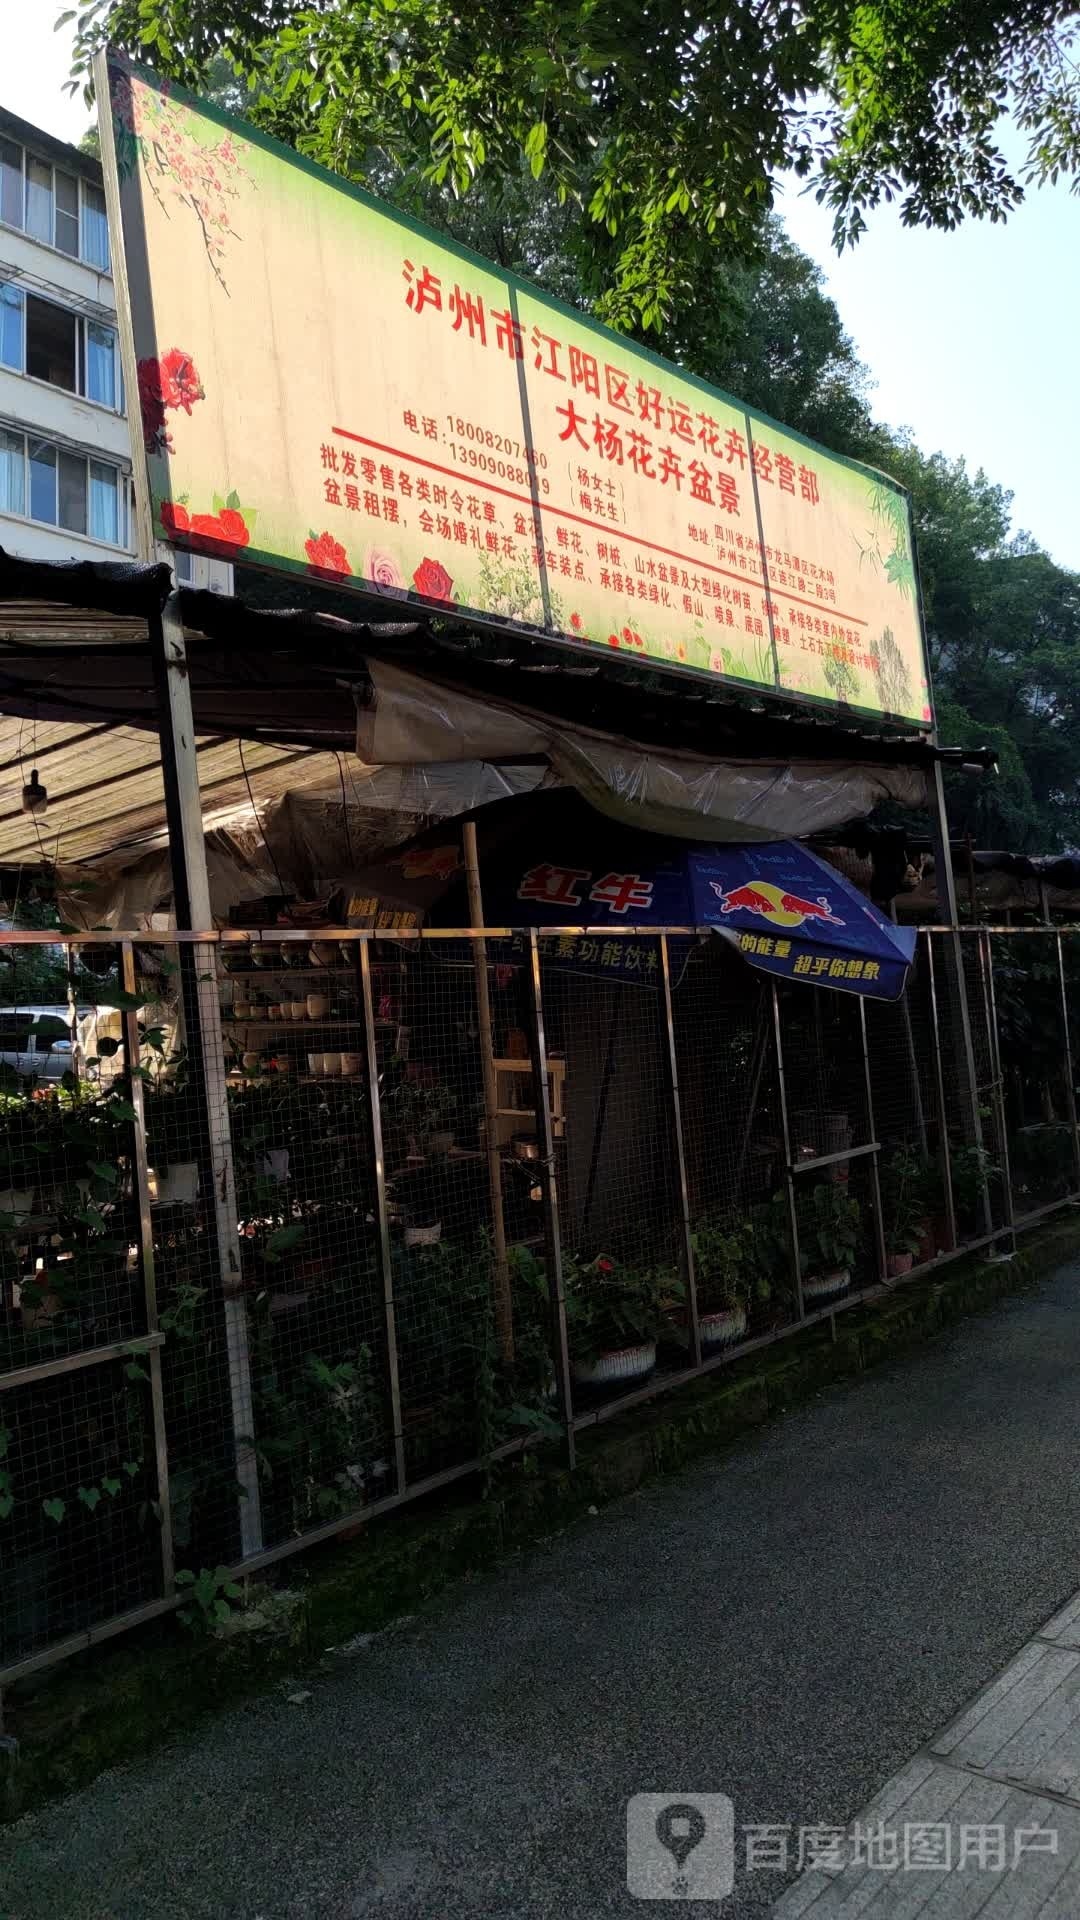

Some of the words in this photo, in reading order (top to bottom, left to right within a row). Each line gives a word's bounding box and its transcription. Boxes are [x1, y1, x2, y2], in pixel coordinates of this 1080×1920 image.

[402, 259, 820, 506] 泸州市江阳区好运花卉经营部
[555, 399, 742, 518] 大杨花卉盆景
[516, 863, 654, 914] 红牛
[793, 954, 881, 980] 超乎你想象
